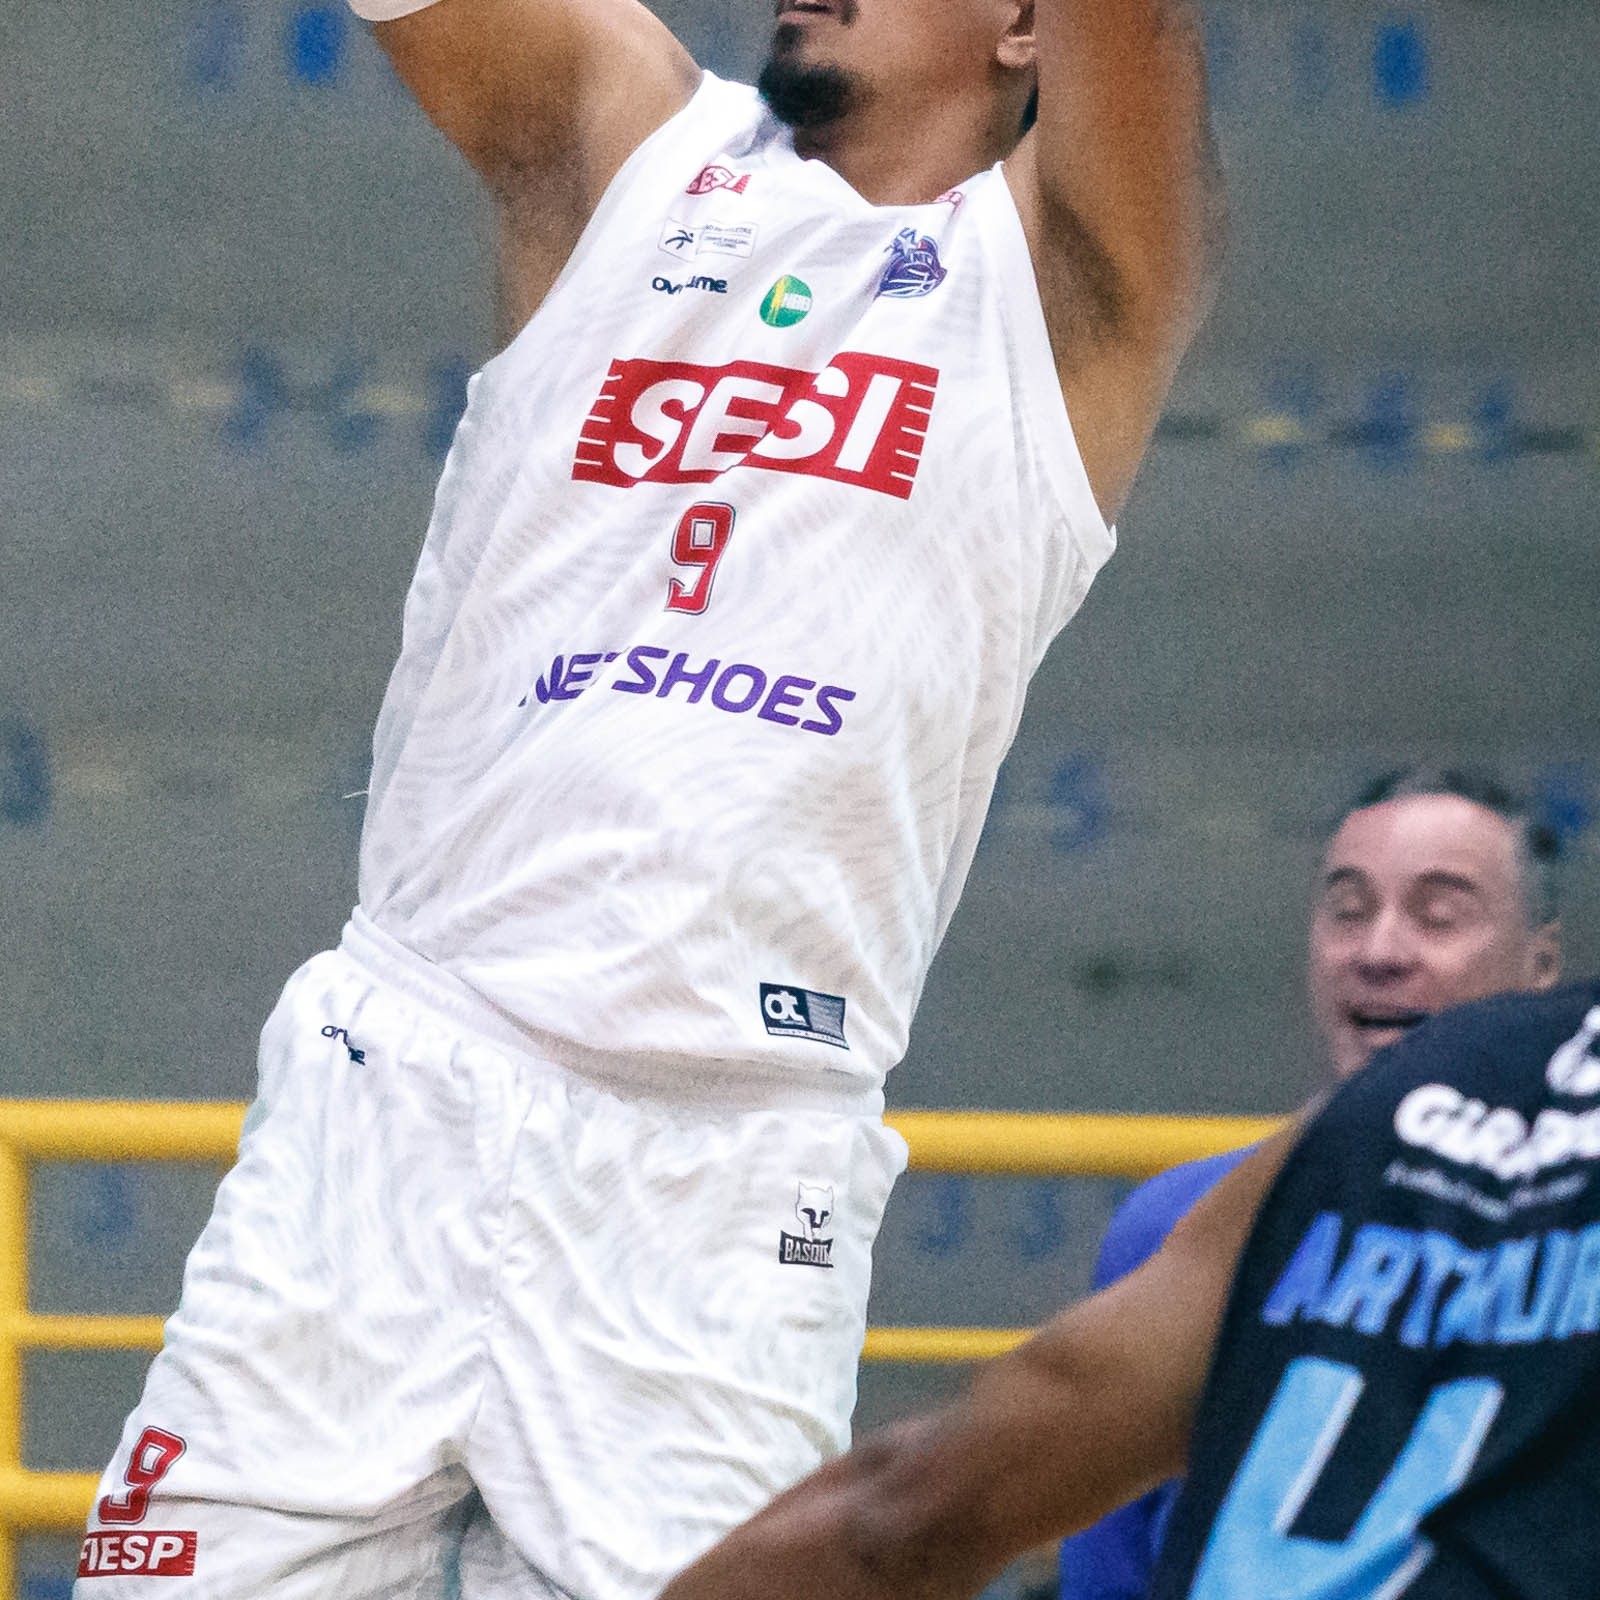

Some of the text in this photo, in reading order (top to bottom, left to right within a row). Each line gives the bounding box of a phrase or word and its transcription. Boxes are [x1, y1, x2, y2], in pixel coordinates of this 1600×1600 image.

[613, 366, 903, 478] SESI
[664, 500, 736, 616] 9
[518, 645, 857, 736] NESHOES
[97, 1424, 188, 1526] 9
